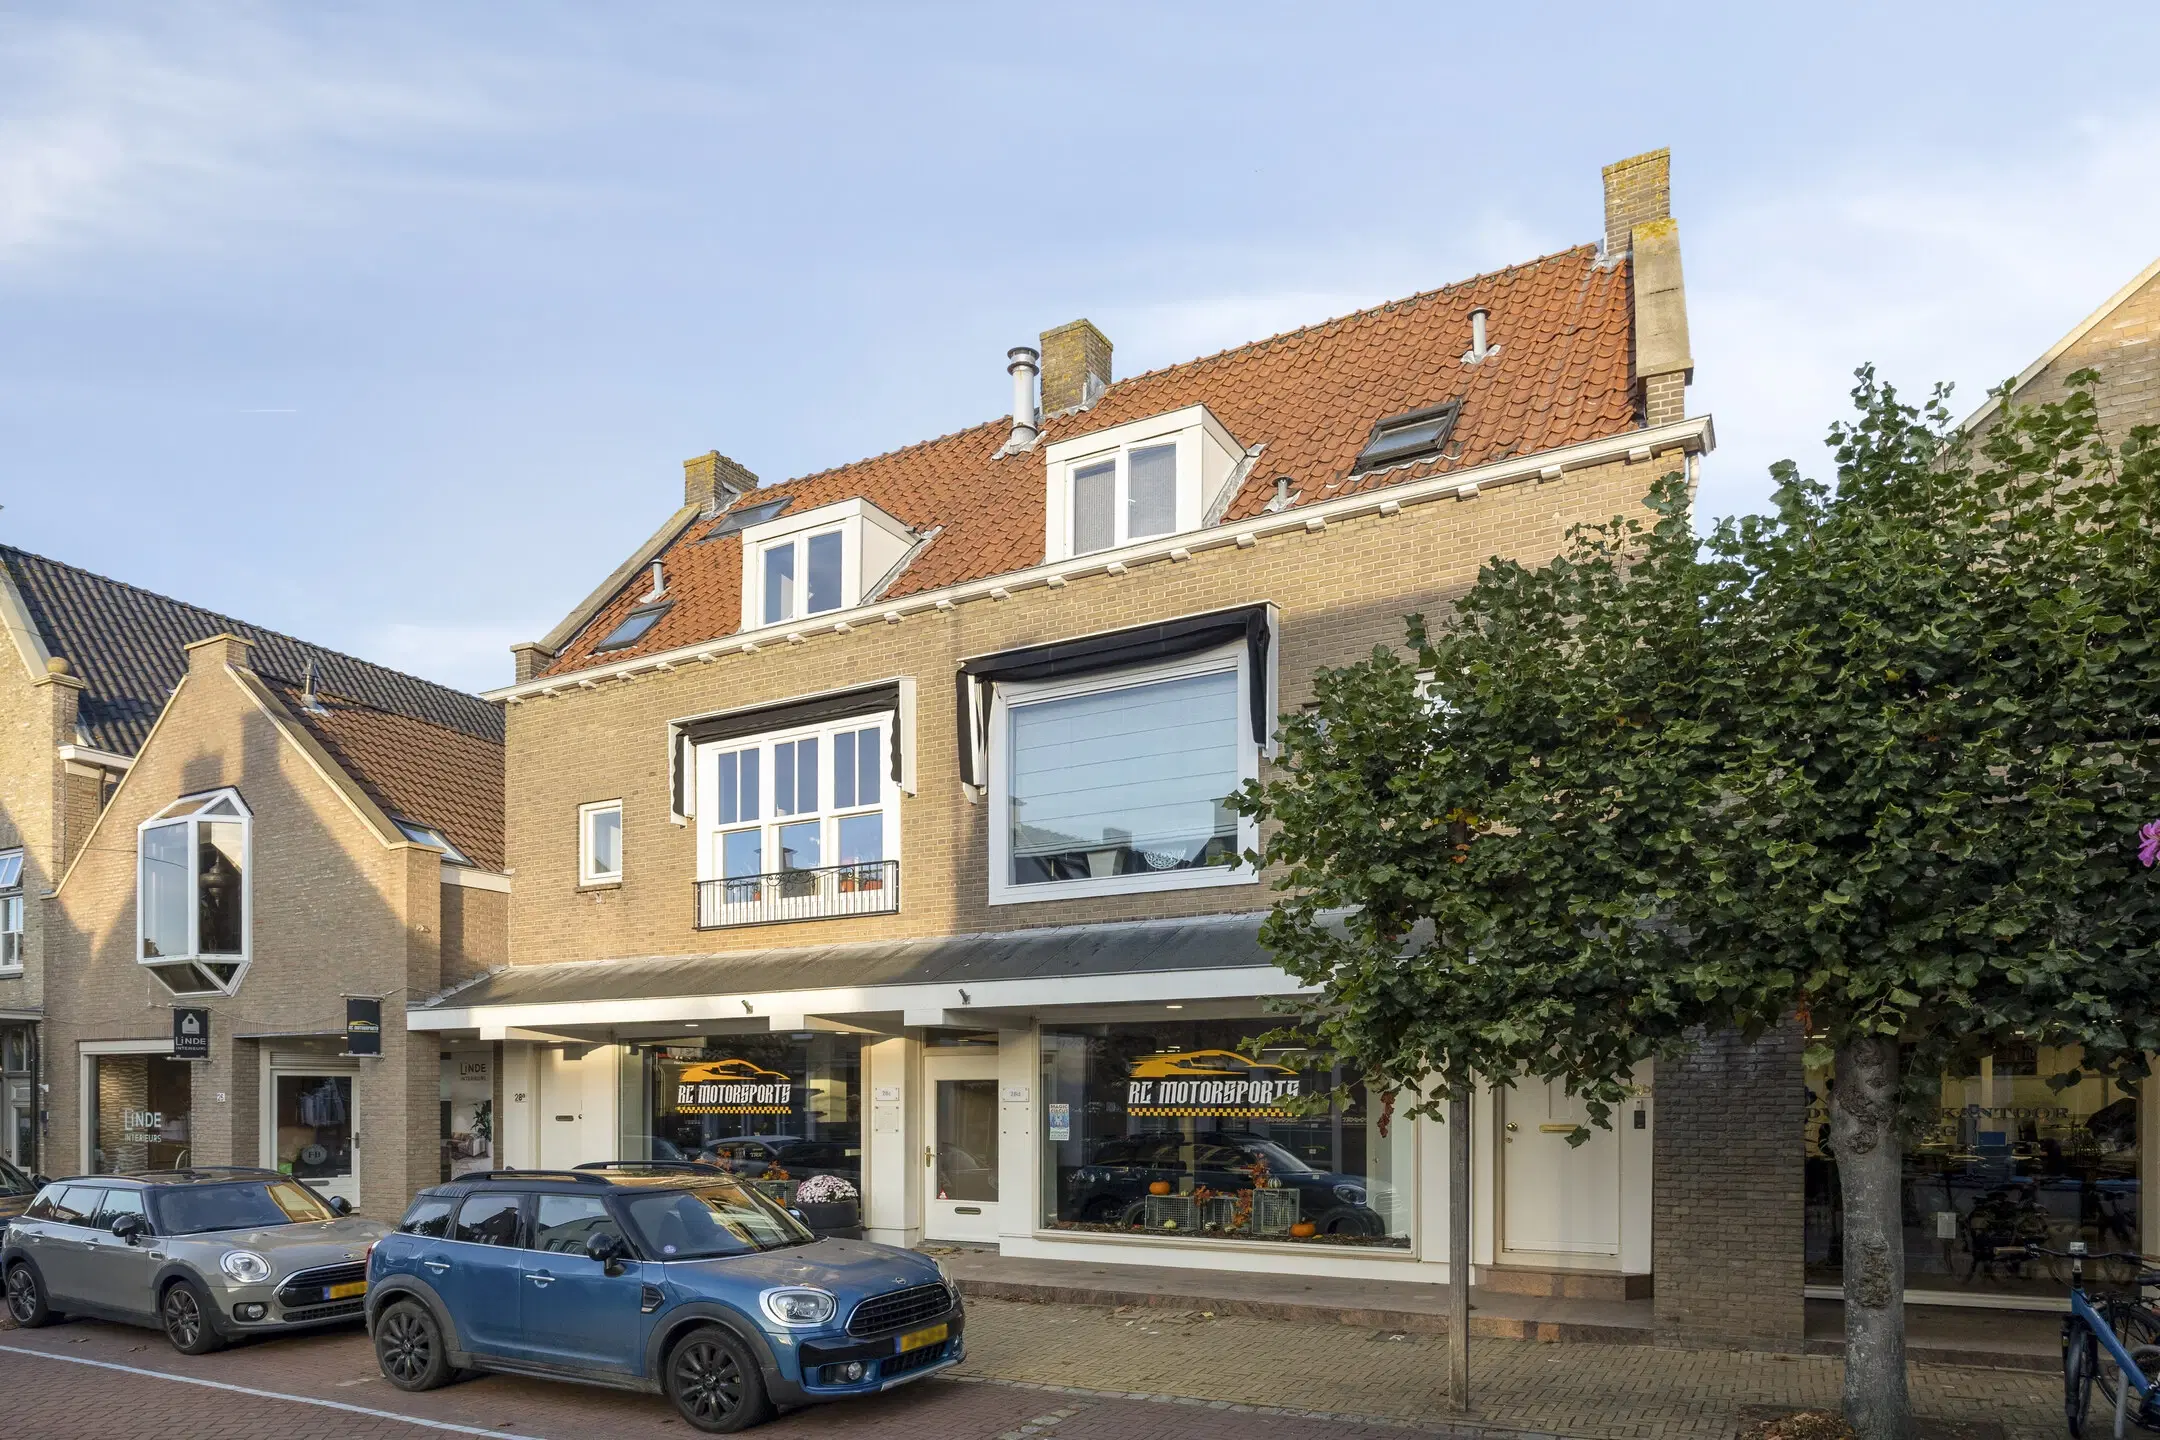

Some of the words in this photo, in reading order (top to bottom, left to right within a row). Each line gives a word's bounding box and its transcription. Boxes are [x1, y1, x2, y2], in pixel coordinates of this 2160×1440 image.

[677, 1085, 694, 1104] RC
[698, 1084, 791, 1104] MOTORSPORTS
[1128, 1081, 1152, 1104] RC
[1159, 1080, 1300, 1104] MOTORSPORTS
